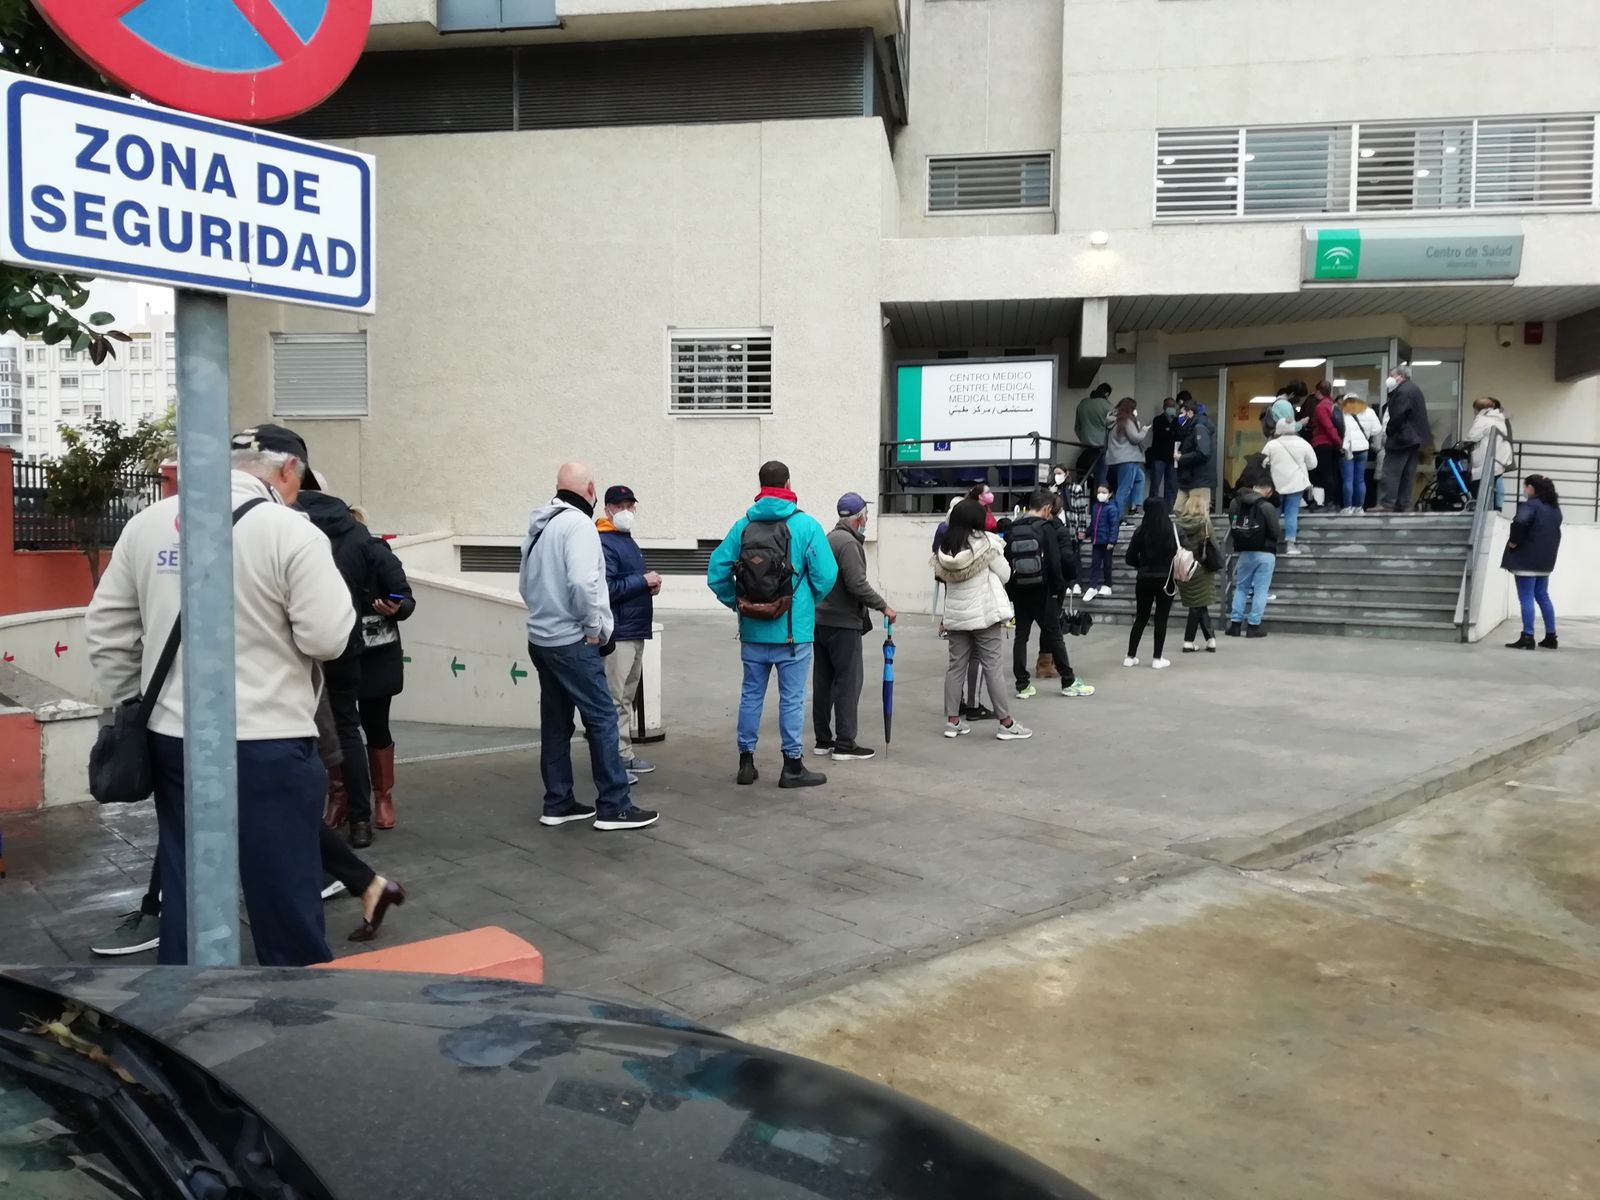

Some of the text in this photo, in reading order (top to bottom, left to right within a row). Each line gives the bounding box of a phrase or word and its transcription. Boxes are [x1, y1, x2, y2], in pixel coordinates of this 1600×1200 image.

[75, 123, 320, 214] ZONA DE
[30, 184, 356, 278] SEGURIDAD
[1426, 244, 1513, 258] Centro de Salud
[949, 371, 1032, 382] CENTRO MEDICO
[949, 382, 1034, 393] CENTRE MEDICAL
[949, 392, 1035, 403] MEDICAL CENTER
